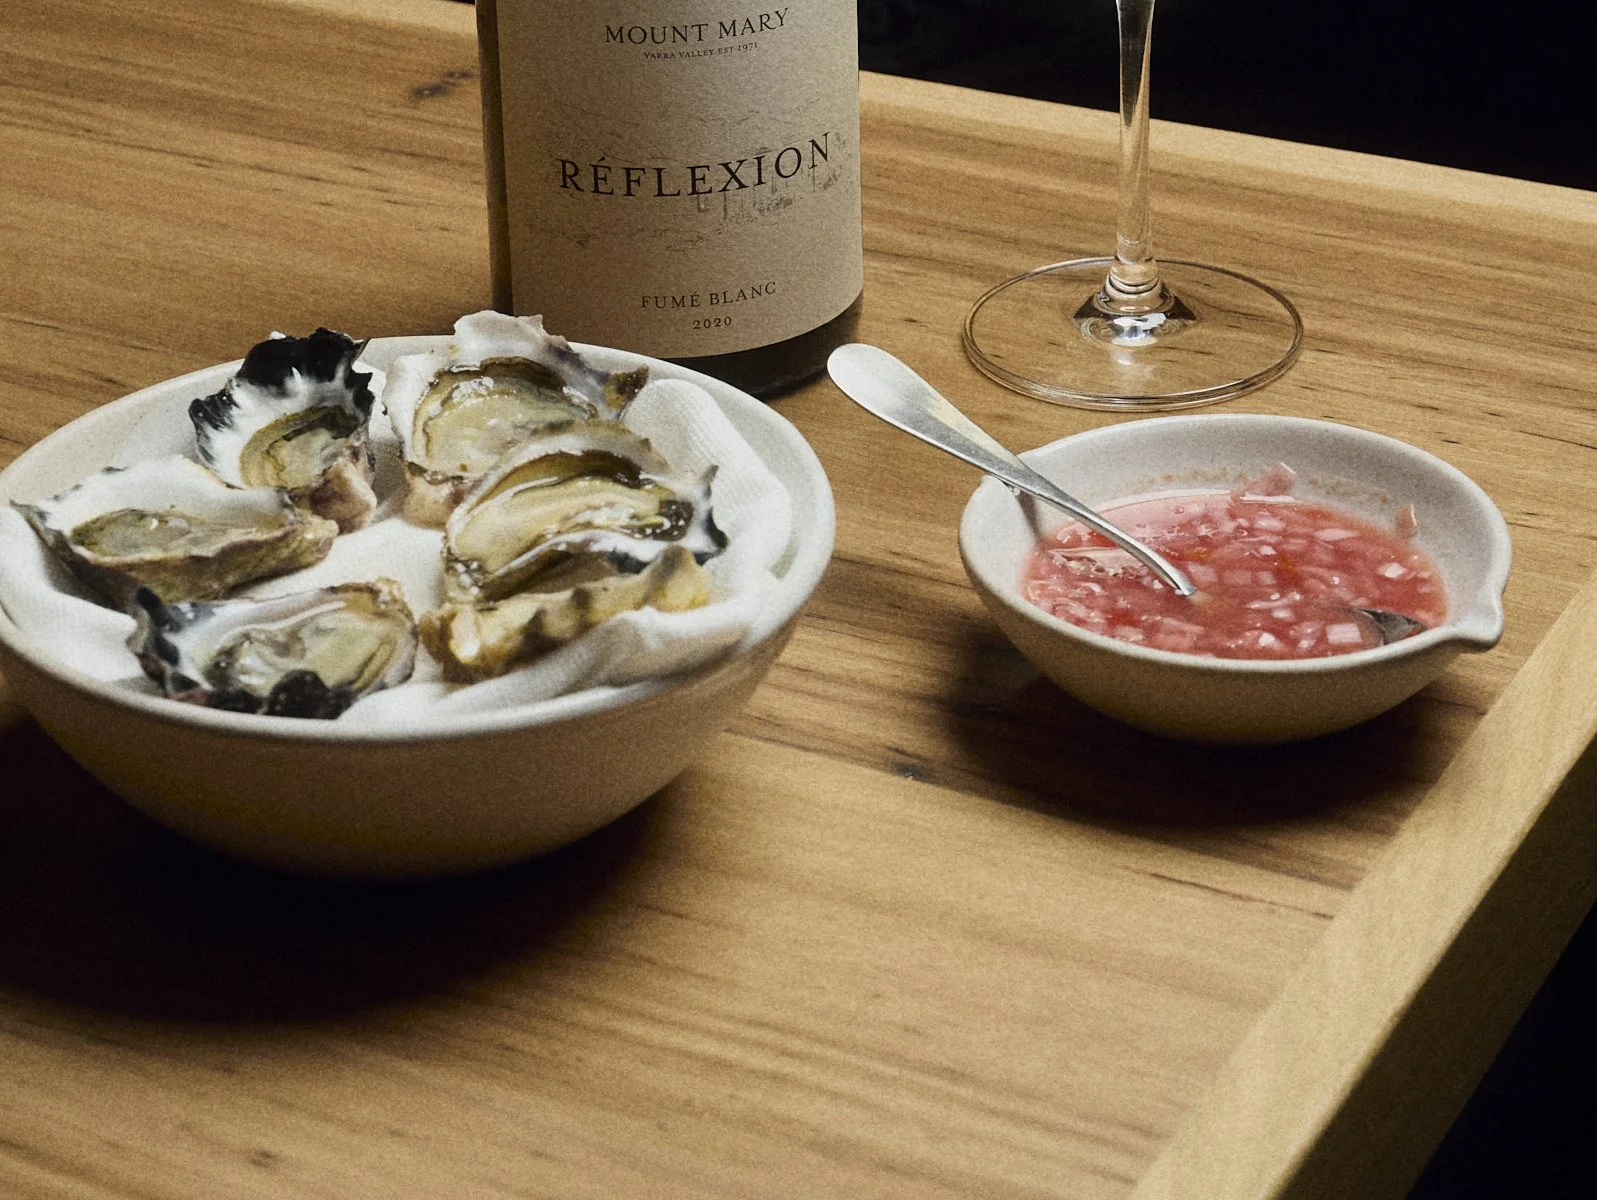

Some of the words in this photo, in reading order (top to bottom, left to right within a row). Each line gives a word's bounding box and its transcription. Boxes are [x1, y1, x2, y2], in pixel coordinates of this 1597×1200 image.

[605, 23, 709, 45] MOUNT
[718, 7, 789, 39] MARY
[644, 51, 677, 60] YARRA
[679, 48, 715, 58] VALLEY
[718, 46, 734, 55] EST
[557, 132, 830, 197] RÉFLEXION
[709, 281, 777, 306] BLANC
[692, 316, 732, 330] 2020
